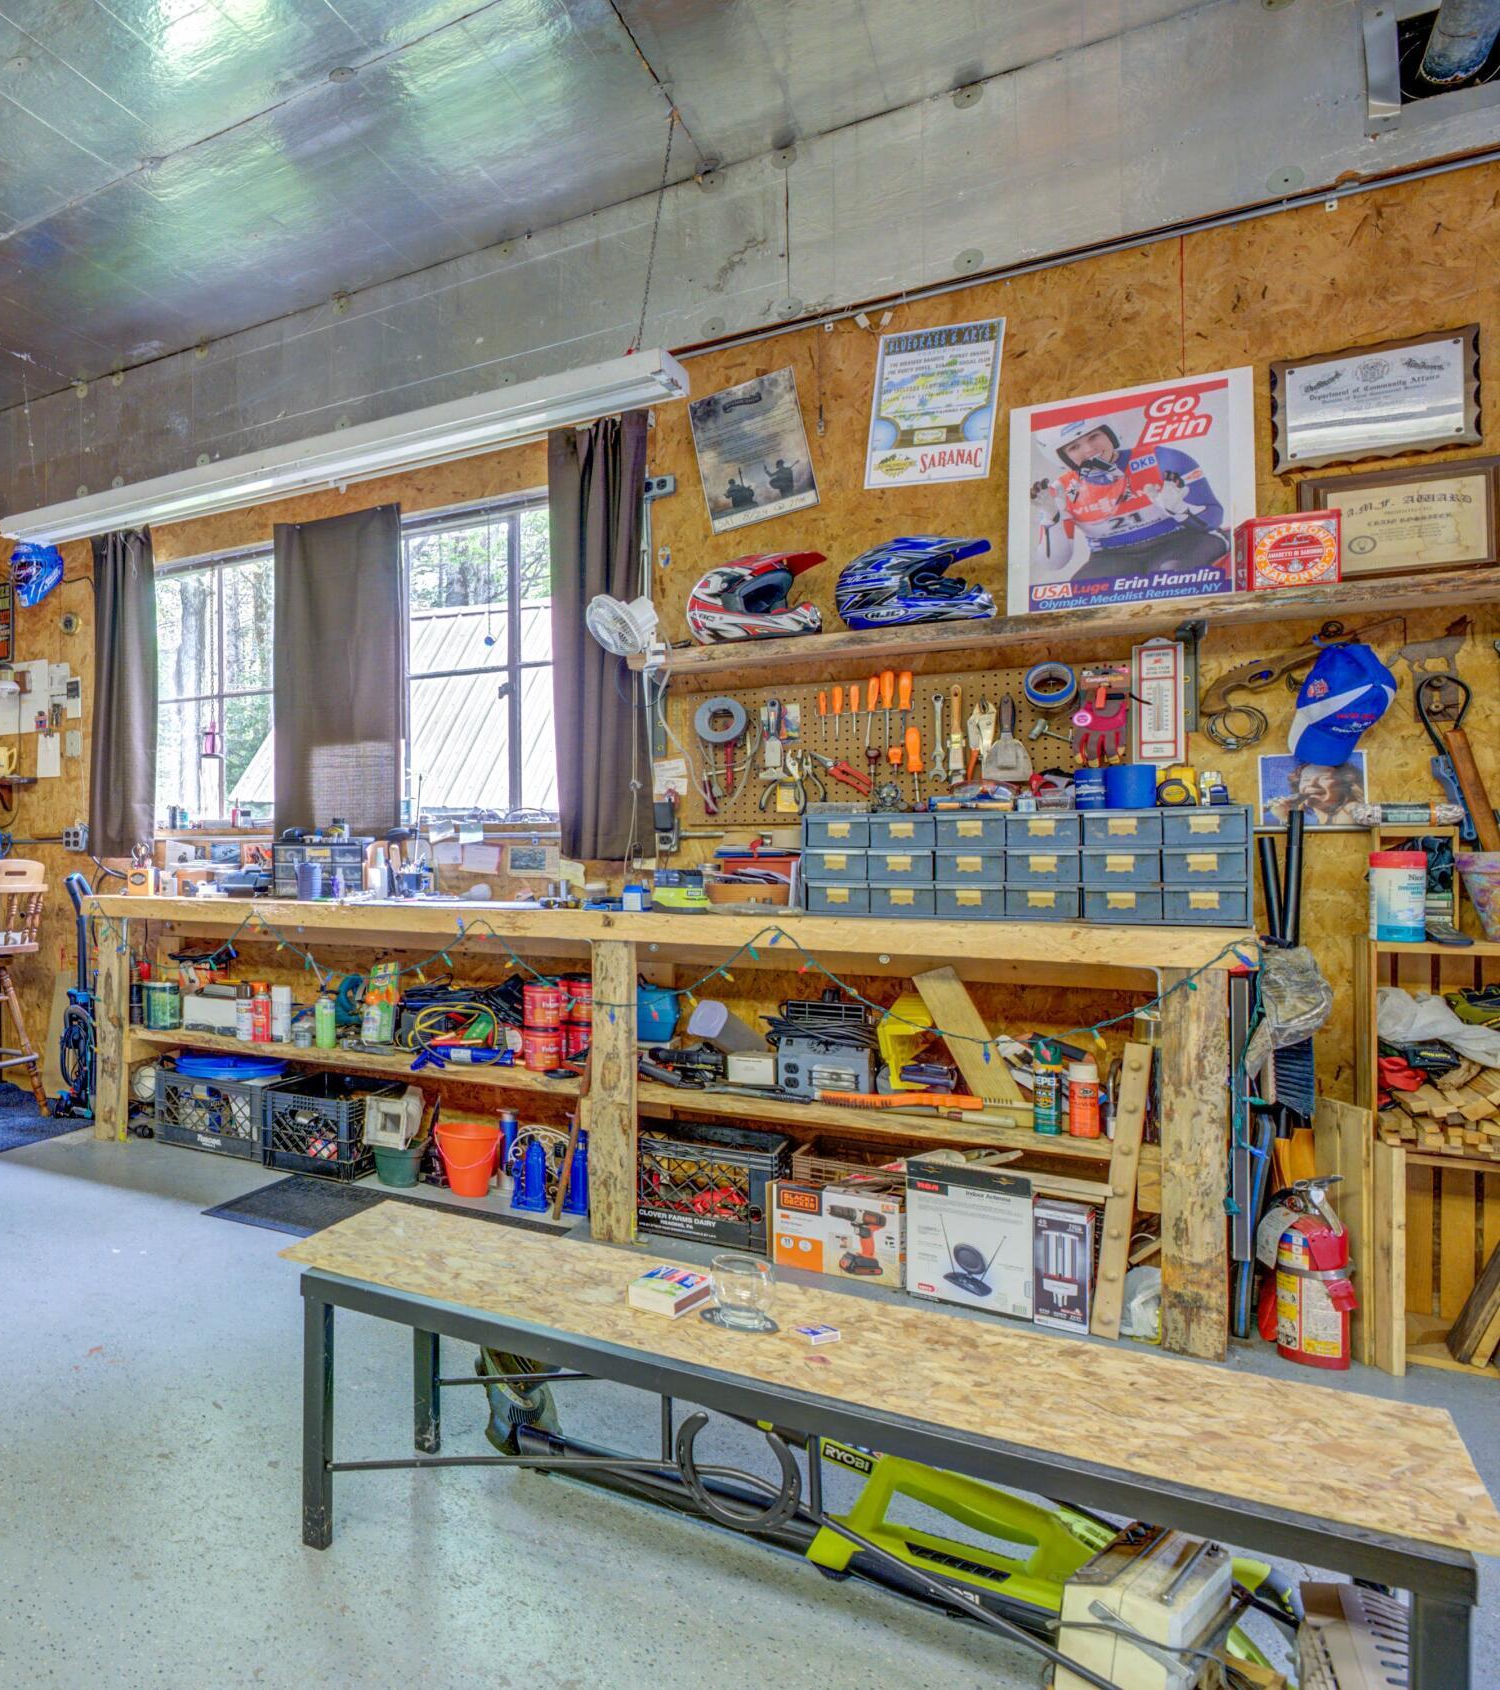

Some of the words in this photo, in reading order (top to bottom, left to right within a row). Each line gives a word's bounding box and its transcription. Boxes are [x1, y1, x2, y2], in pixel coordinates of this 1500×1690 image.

[1309, 389, 1350, 401] Department
[1363, 380, 1407, 392] Community
[1409, 374, 1441, 385] Affairs
[1149, 394, 1196, 418] Go
[1142, 415, 1208, 444] Erin
[919, 447, 983, 474] SARANAC
[1130, 455, 1157, 473] DKB
[1108, 511, 1142, 530] 21
[1032, 583, 1072, 600] USA
[1073, 582, 1110, 595] Luge
[1113, 575, 1149, 591] Erin
[1152, 568, 1221, 587] Hamlin
[1038, 596, 1092, 610] Olympic
[1091, 590, 1144, 605] Medalist
[1147, 584, 1200, 598] Remsen,
[1202, 582, 1222, 593] NY
[868, 609, 901, 619] HJC
[916, 1181, 939, 1191] RCA
[965, 1190, 984, 1198] Indoor
[985, 1193, 1011, 1203] Antenna
[783, 1198, 815, 1209] DECKER
[638, 1208, 668, 1220] CLOVER
[668, 1214, 693, 1224] FARMS
[693, 1218, 717, 1228] DAIRY
[824, 1443, 871, 1472] RYOBI
